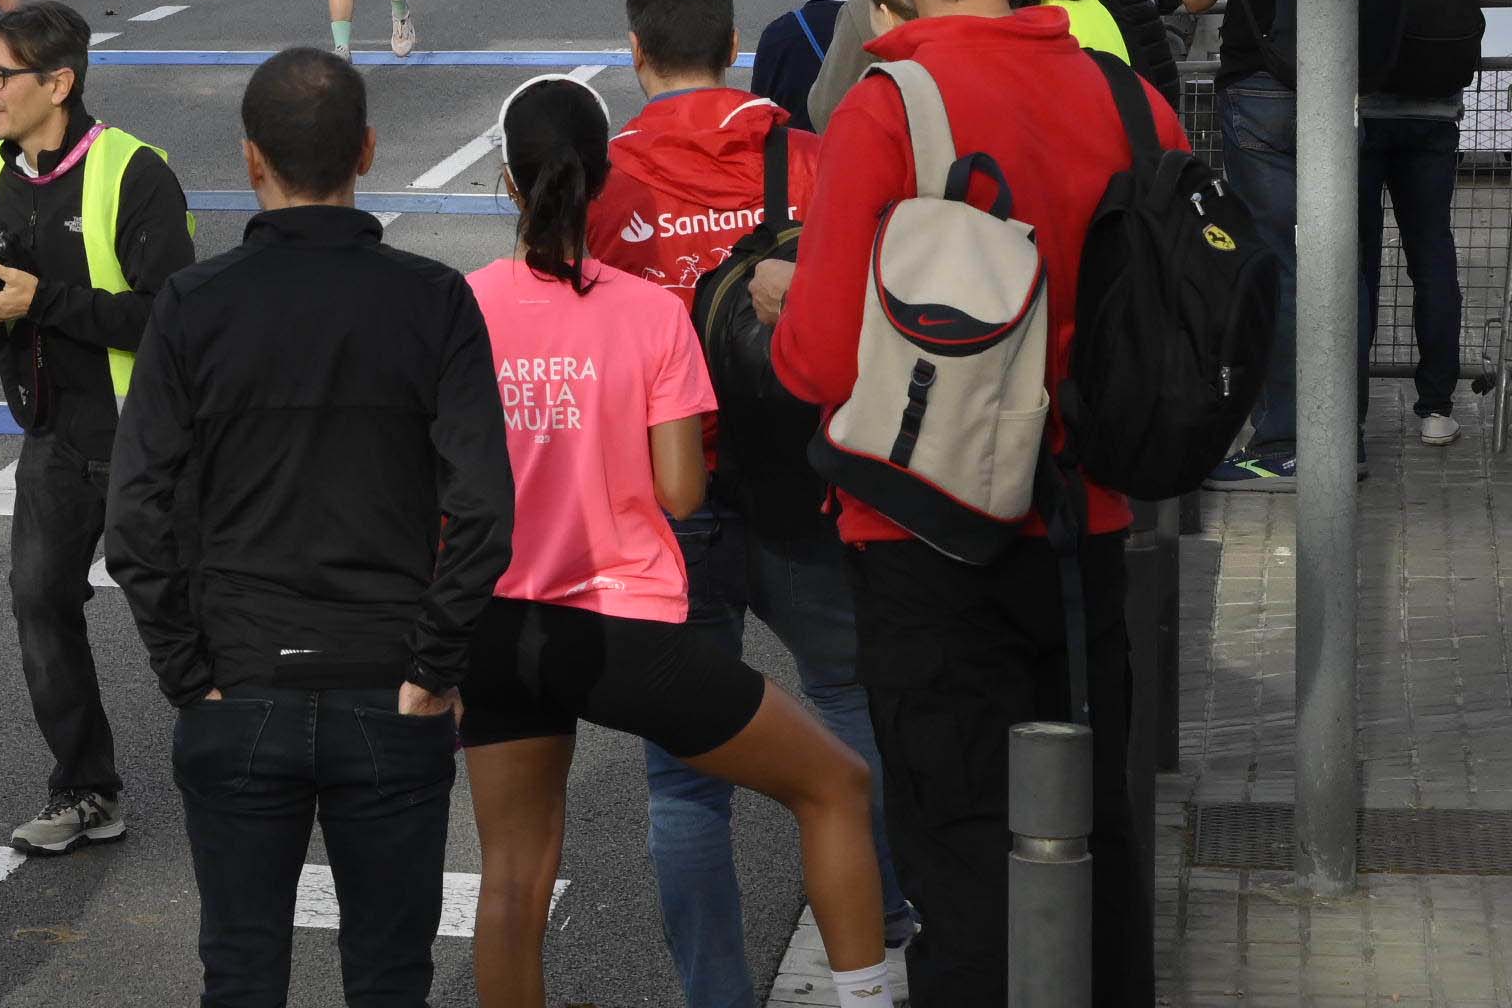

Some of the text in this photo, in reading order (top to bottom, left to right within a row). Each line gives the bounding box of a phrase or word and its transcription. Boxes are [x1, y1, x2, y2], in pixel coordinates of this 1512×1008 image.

[497, 357, 598, 382] ARRERA
[504, 382, 576, 407] DE LA
[504, 408, 582, 431] MUJER
